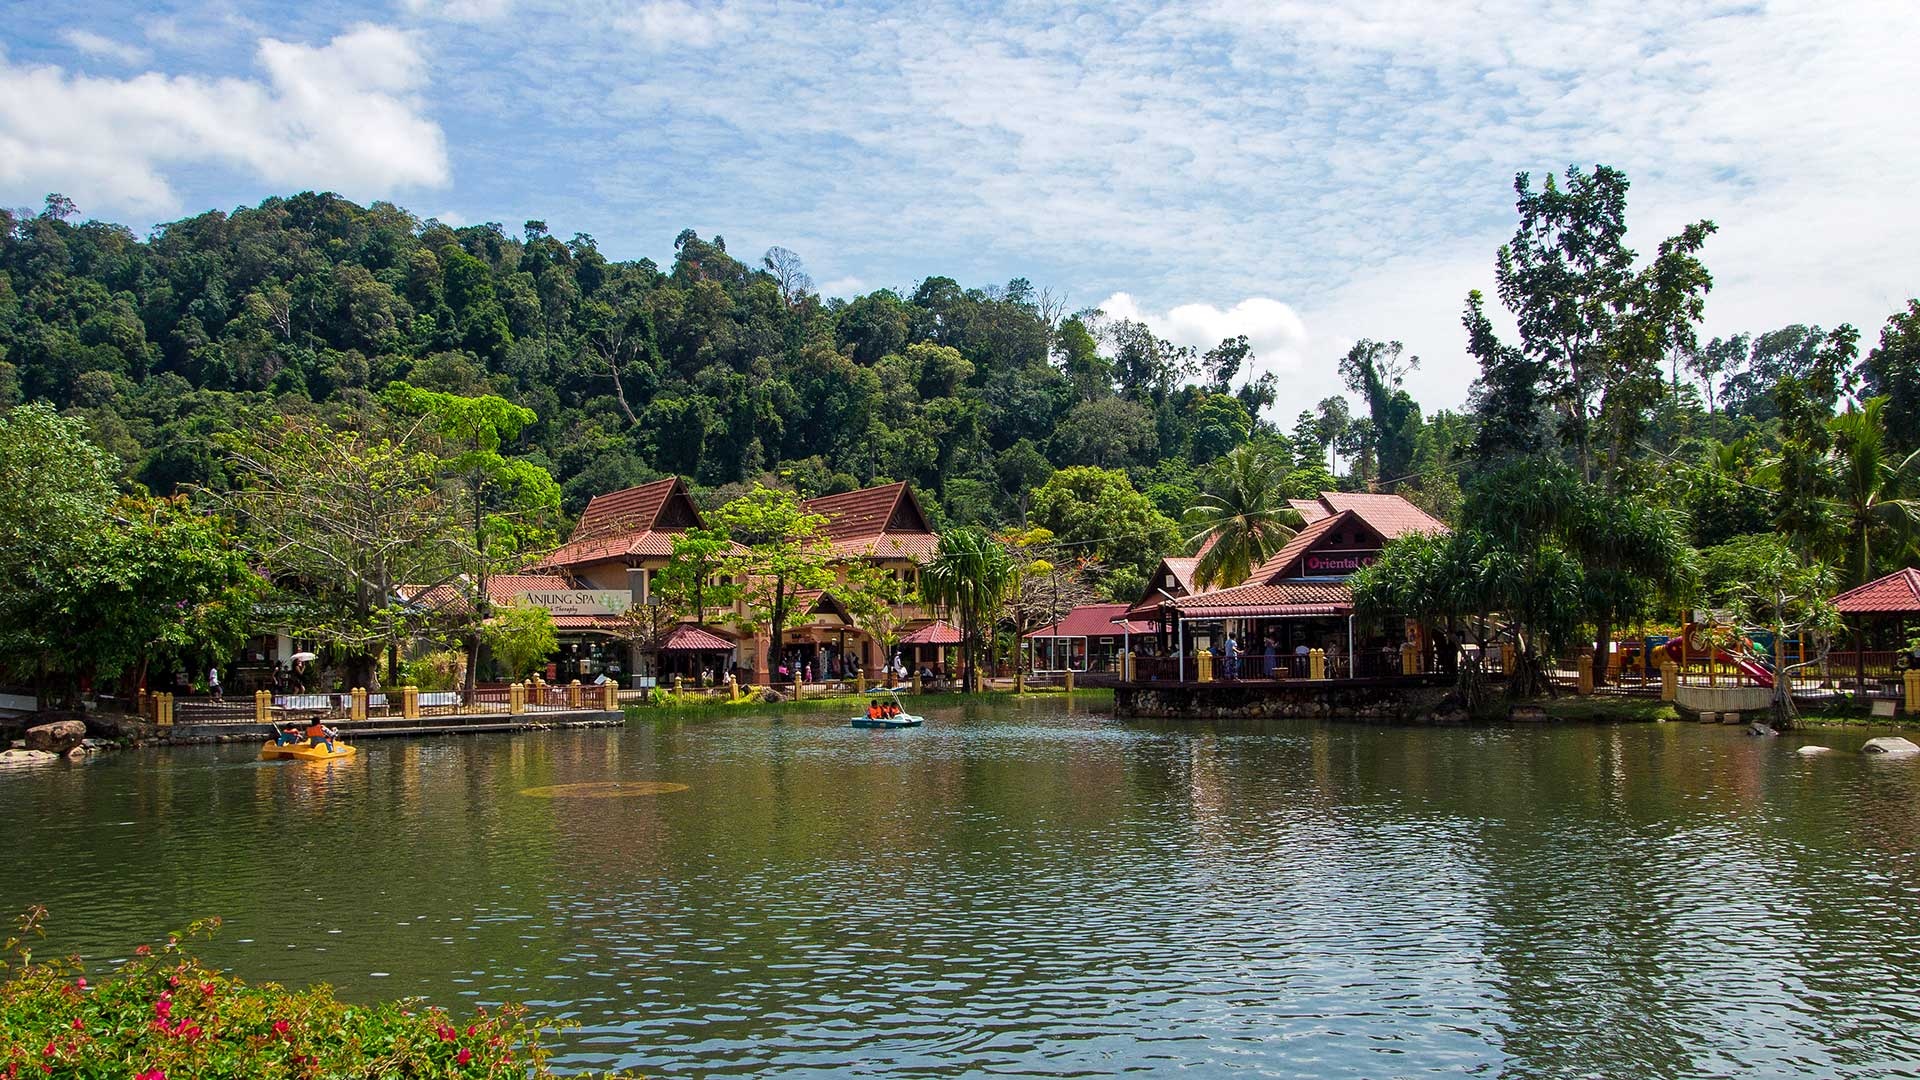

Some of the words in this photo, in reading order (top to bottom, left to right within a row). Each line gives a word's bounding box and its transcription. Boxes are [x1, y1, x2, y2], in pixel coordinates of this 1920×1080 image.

[1309, 557, 1359, 569] Oriental
[526, 592, 572, 607] ANJUNG
[575, 592, 595, 605] SPA
